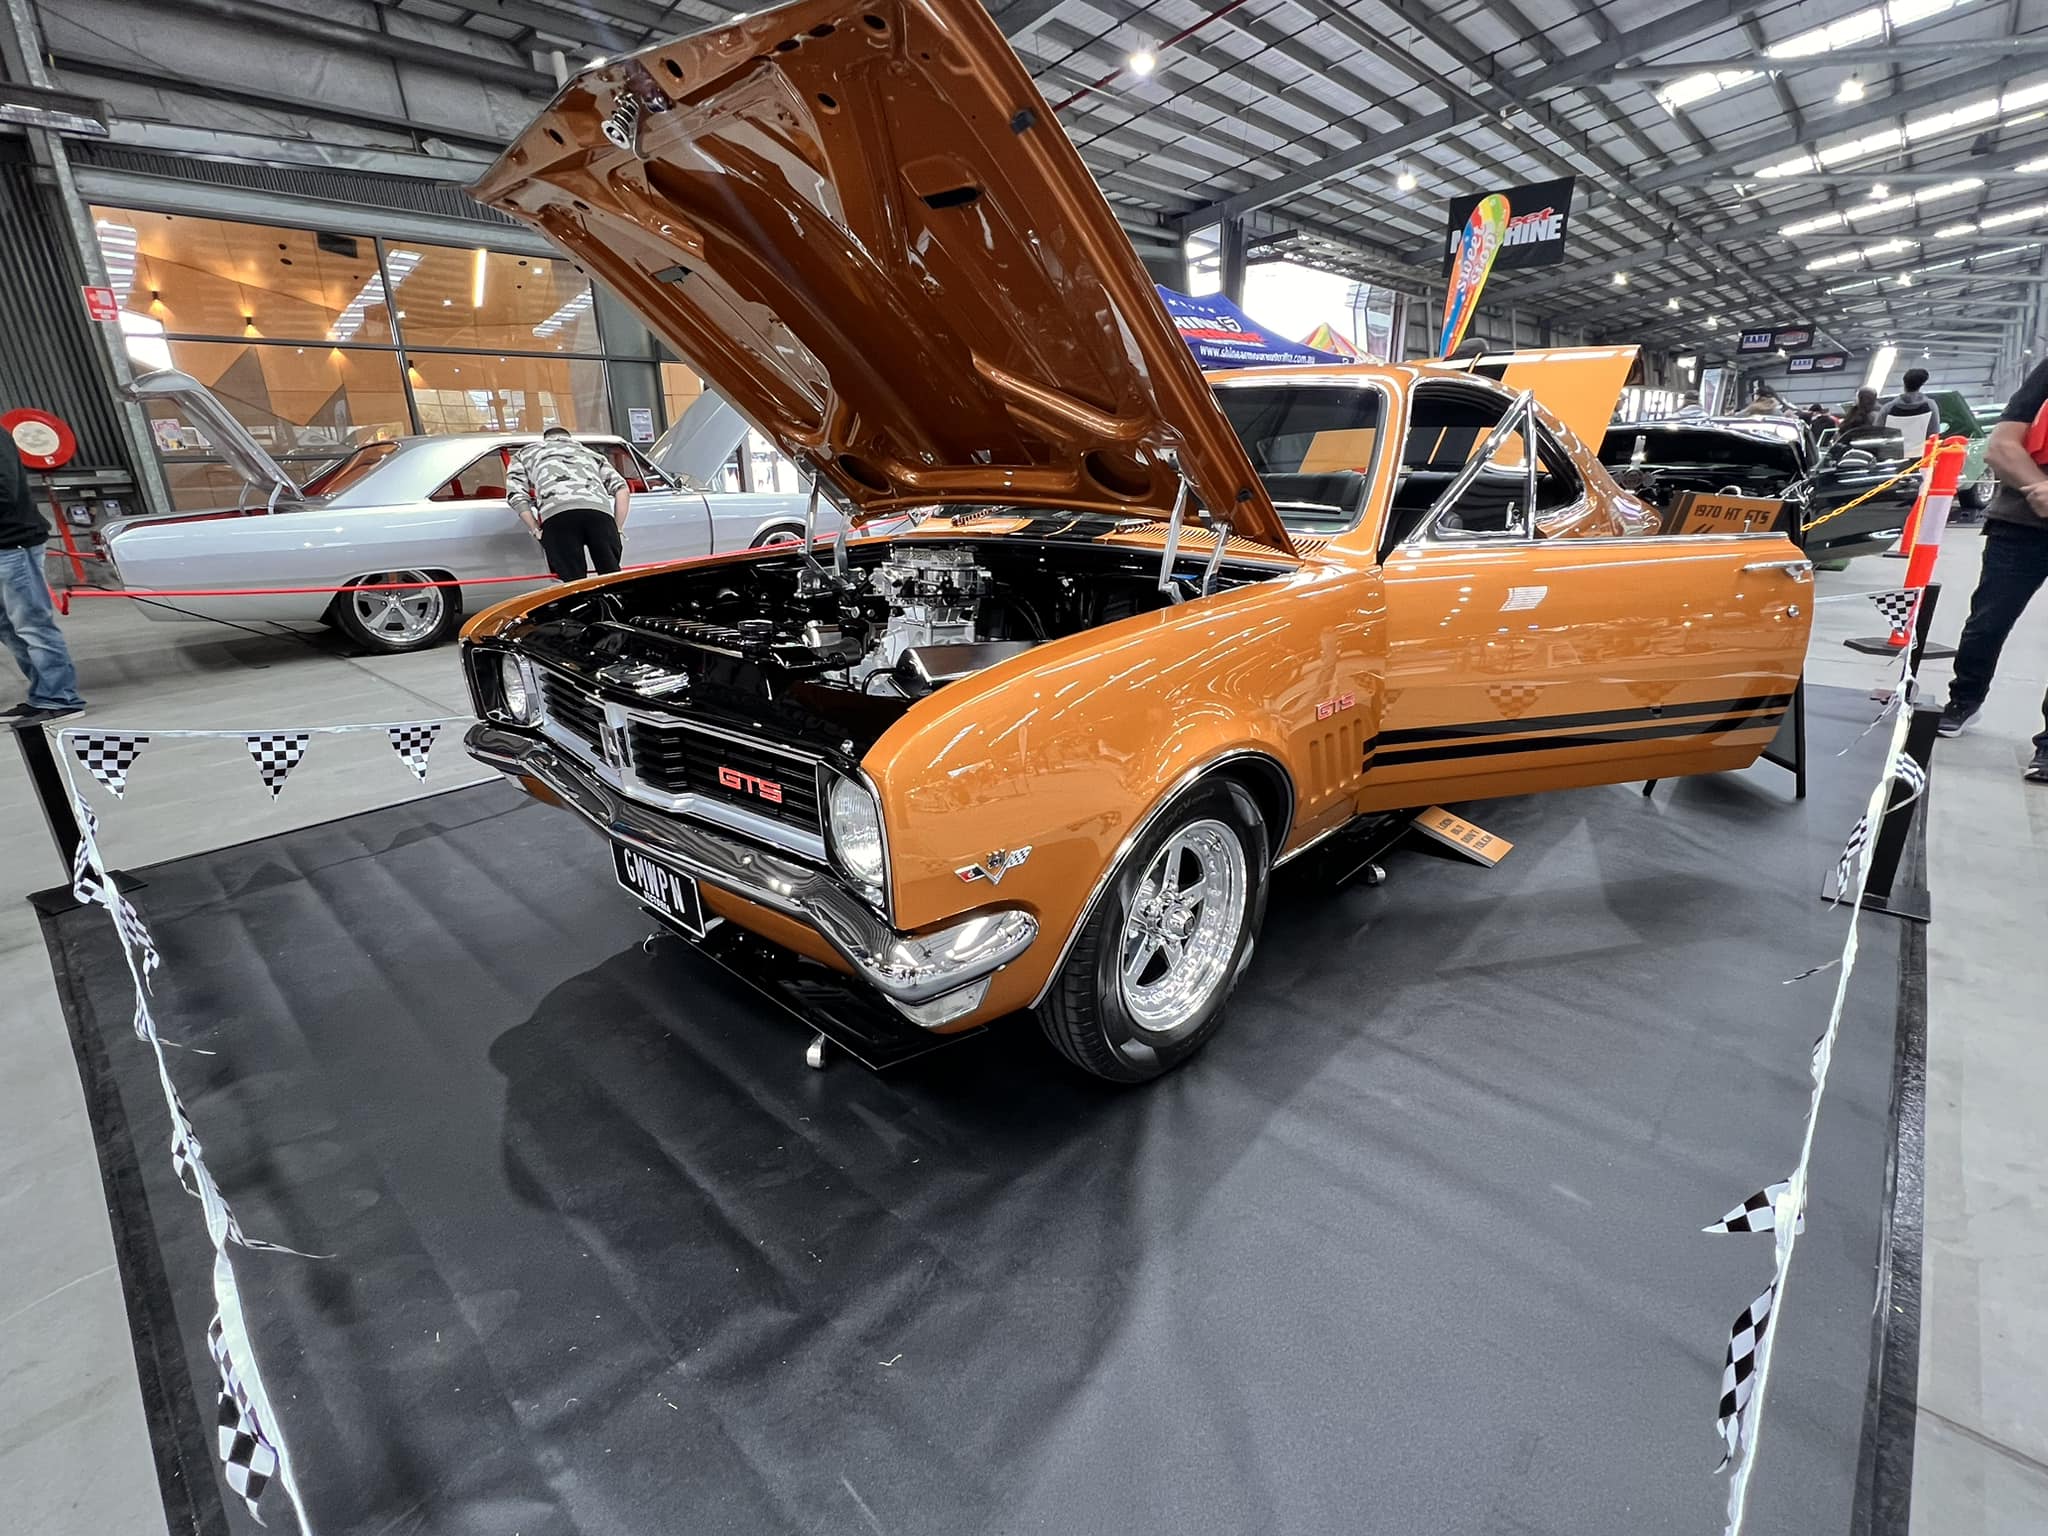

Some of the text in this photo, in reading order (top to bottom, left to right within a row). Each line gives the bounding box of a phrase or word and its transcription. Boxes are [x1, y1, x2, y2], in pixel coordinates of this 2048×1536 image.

[1694, 504, 1771, 525] 1970 HT GTS
[1315, 692, 1355, 721] GTS
[718, 766, 782, 804] GTS
